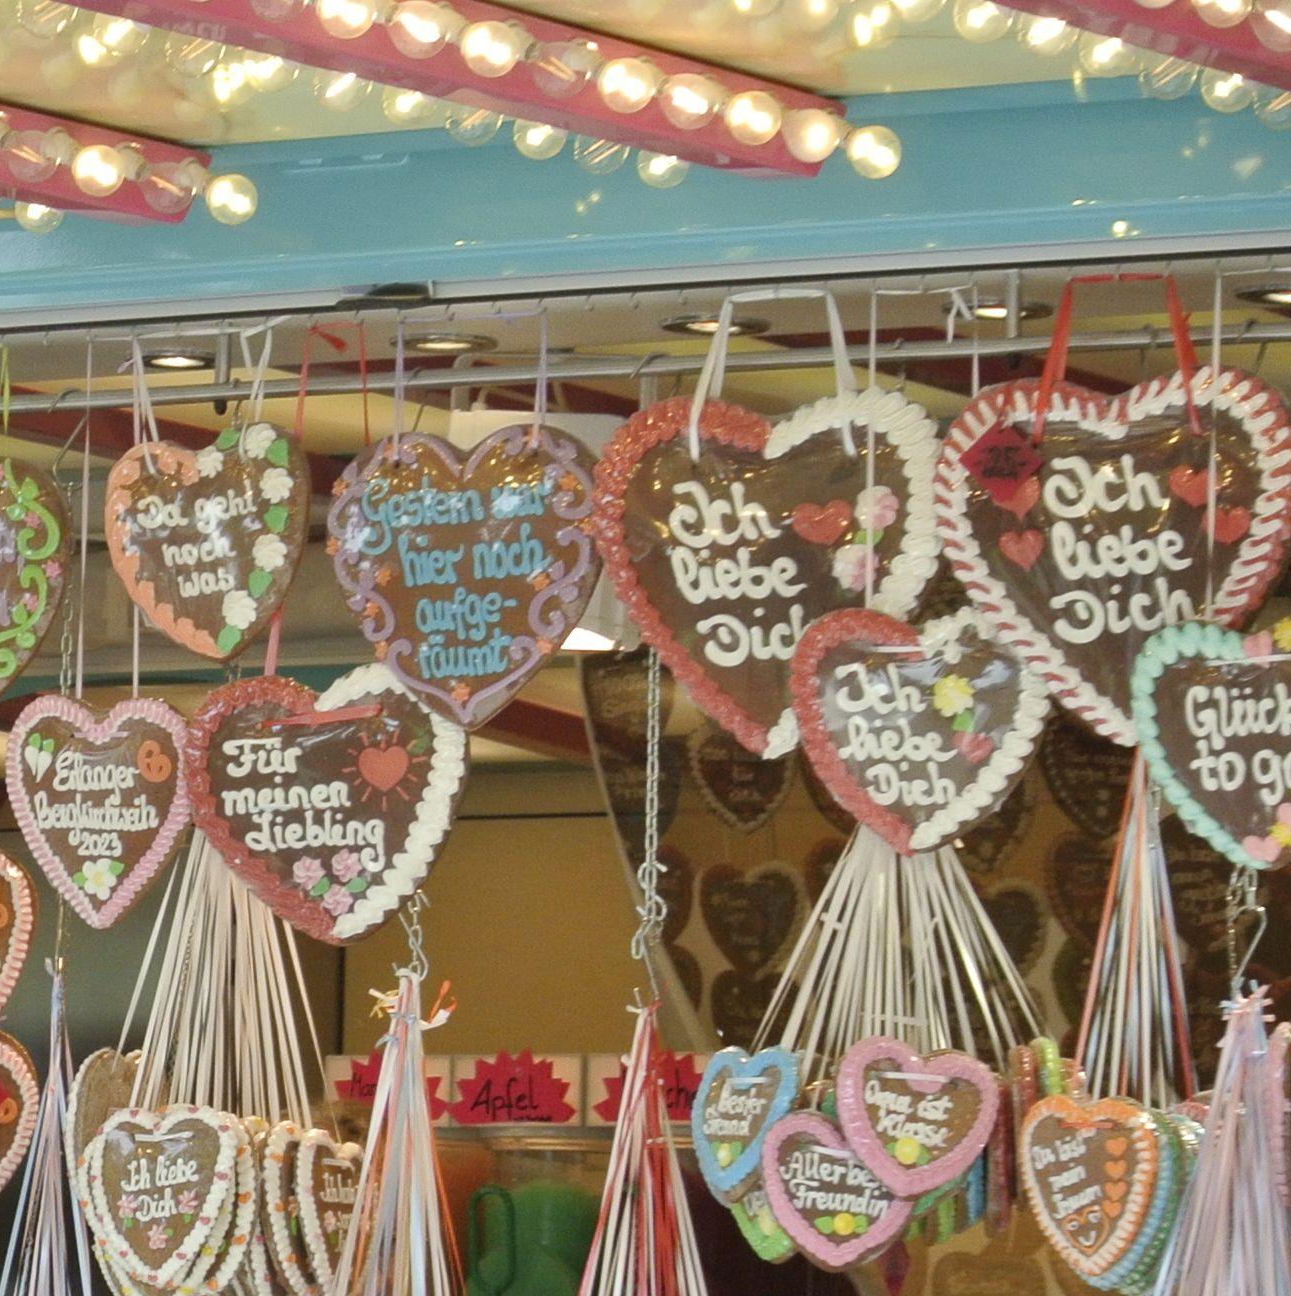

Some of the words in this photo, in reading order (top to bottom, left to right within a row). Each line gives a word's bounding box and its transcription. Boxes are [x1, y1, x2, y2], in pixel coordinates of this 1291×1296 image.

[136, 494, 189, 529] Da
[194, 479, 258, 535] geht
[1042, 453, 1171, 519] Ich
[360, 475, 485, 555] Gestern
[669, 479, 782, 549] Ich
[162, 531, 236, 567] noch
[397, 533, 464, 588] hier
[471, 523, 554, 579] noch
[1049, 520, 1193, 581] liebe
[177, 567, 236, 598] was
[669, 546, 808, 604] liebe
[415, 586, 518, 641] aufge-
[1048, 577, 1198, 644] Dich
[419, 627, 515, 678] räumt
[834, 662, 927, 715] Ich
[222, 737, 303, 778] Für
[837, 715, 958, 764] liebe
[1189, 739, 1246, 791] to
[51, 750, 139, 803] Erlanger
[221, 776, 351, 815] meinen
[865, 762, 957, 807] Dich
[76, 833, 122, 856] 2023
[244, 812, 385, 874] Liebling
[470, 1073, 539, 1122] Apfel
[865, 1079, 912, 1115] Oma
[917, 1095, 953, 1121] ist
[121, 1158, 152, 1192] Ich
[155, 1155, 199, 1186] liebe
[788, 1177, 890, 1219] Freundin
[135, 1188, 178, 1221] Dich
